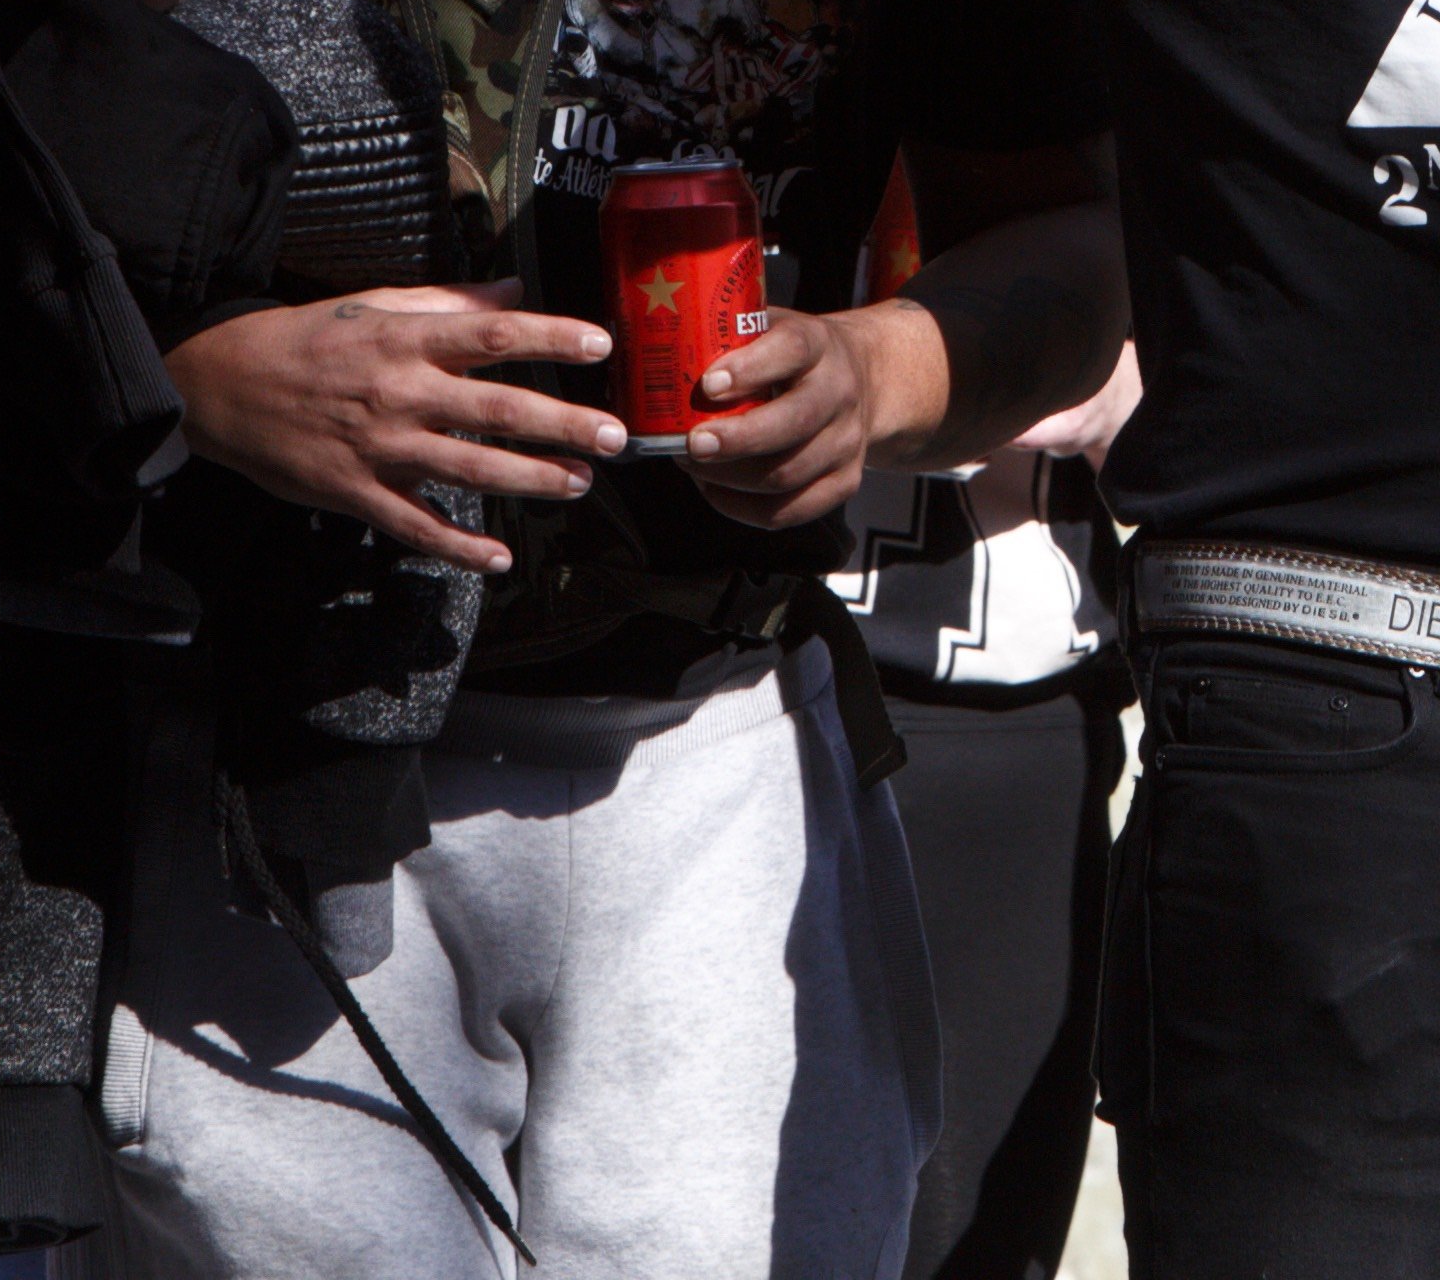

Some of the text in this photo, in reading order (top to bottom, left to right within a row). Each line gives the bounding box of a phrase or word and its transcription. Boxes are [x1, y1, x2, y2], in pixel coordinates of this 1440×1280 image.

[552, 154, 612, 202] Atléti
[1179, 564, 1200, 576] BELT
[1201, 565, 1210, 576] IS
[1210, 565, 1240, 579] MADE
[1241, 568, 1254, 579] IN
[1255, 569, 1306, 586] GENUINE
[1307, 577, 1368, 597] MATERIAL
[1199, 579, 1242, 592] HIGHEST
[1243, 582, 1294, 598] QUALITY
[1296, 589, 1313, 601] TO
[1206, 594, 1227, 605] AND
[1227, 595, 1281, 611] DESIGNED
[1282, 601, 1300, 613] BY
